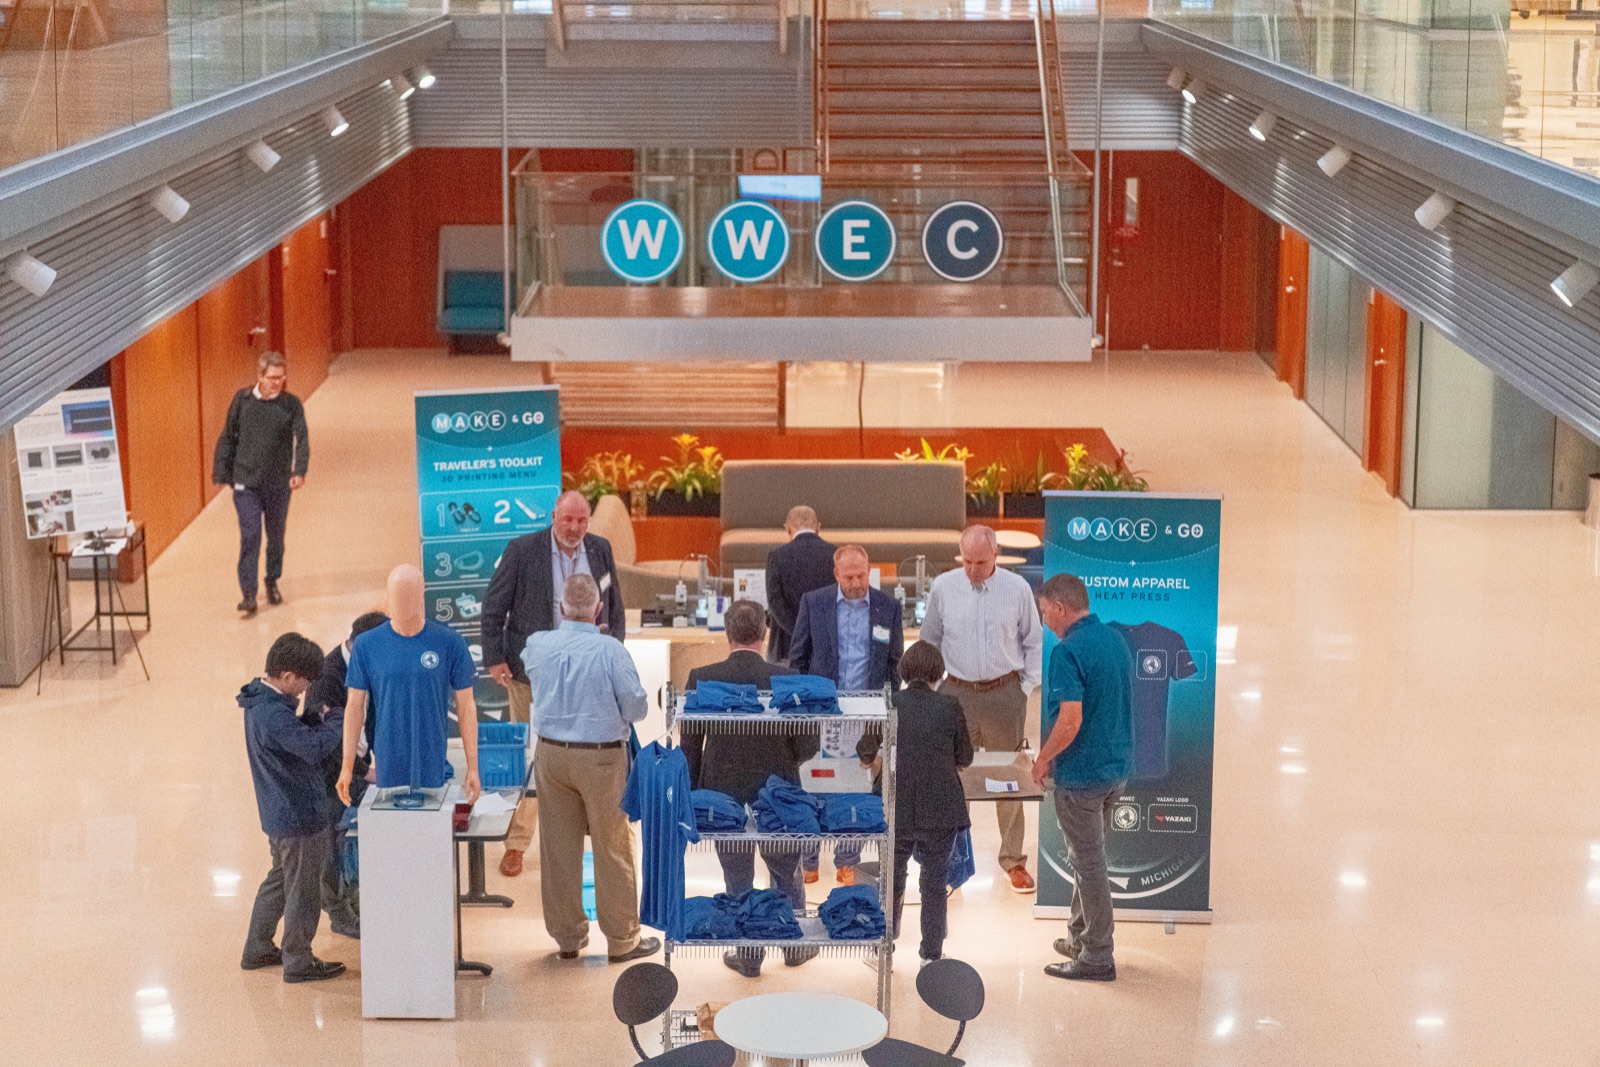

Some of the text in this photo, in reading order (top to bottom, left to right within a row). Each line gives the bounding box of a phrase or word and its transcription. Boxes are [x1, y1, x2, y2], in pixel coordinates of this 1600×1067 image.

[434, 411, 545, 430] MAKE & GO
[433, 456, 543, 471] TRAVELER'S TOOLKIT
[457, 472, 505, 482] PRINTING
[509, 470, 537, 479] MENU
[436, 503, 445, 527] 1
[494, 499, 511, 524] 2
[1072, 522, 1204, 539] MAKE & GO
[434, 552, 452, 577] 3
[1132, 577, 1190, 590] APPAREL
[1095, 590, 1170, 602] HEAT PRESS
[435, 598, 454, 622] 5
[1165, 815, 1192, 823] YAZAKI
